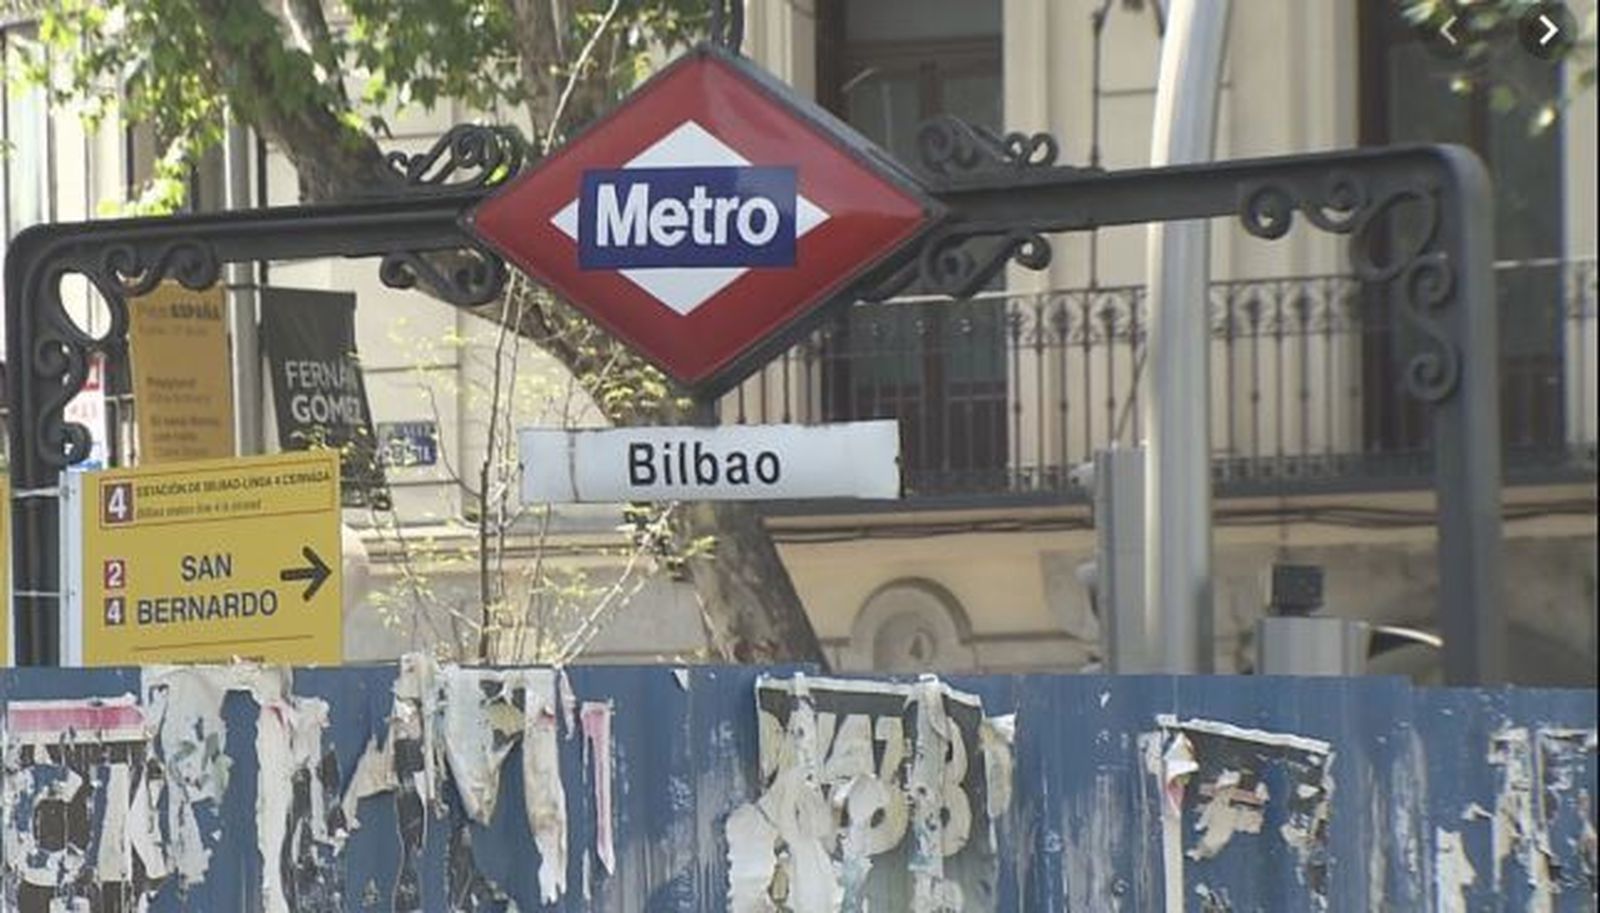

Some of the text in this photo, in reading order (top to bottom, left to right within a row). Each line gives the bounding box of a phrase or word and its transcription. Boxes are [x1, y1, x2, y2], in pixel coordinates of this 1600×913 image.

[595, 182, 780, 249] Metro
[628, 441, 782, 487] Bilbao
[108, 486, 127, 519] 4
[108, 562, 122, 588] 2
[181, 555, 232, 582] SAN
[107, 598, 121, 624] 4
[137, 589, 279, 625] BERNARDO
